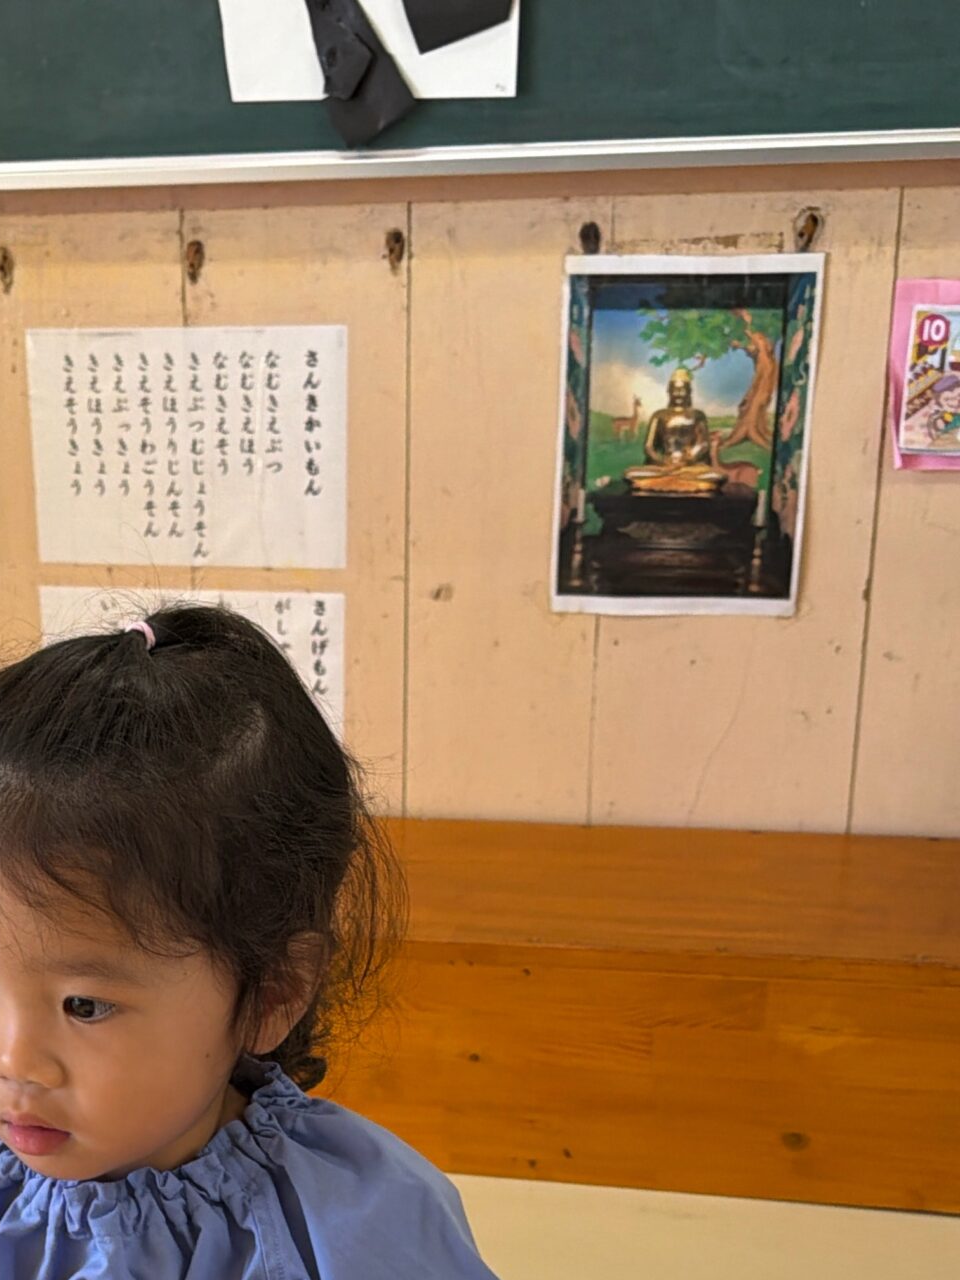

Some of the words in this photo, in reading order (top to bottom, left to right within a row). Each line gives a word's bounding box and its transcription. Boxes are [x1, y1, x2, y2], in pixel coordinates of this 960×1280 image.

[922, 318, 946, 342] 10
[63, 352, 82, 496] きえそうきょう
[87, 352, 106, 496] きえほうきょう
[112, 352, 130, 496] きえぶっきょう
[138, 352, 159, 538] きえそうわごうそん
[162, 352, 184, 538] きえほうりじんそん
[187, 352, 209, 558] きえぶつむじょうそん
[213, 351, 230, 475] なむきえそう
[238, 351, 256, 475] なむきえほう
[264, 351, 283, 474] なむきえぶつ
[302, 350, 322, 496] さんきかいもん
[311, 601, 329, 695] さんげもん
